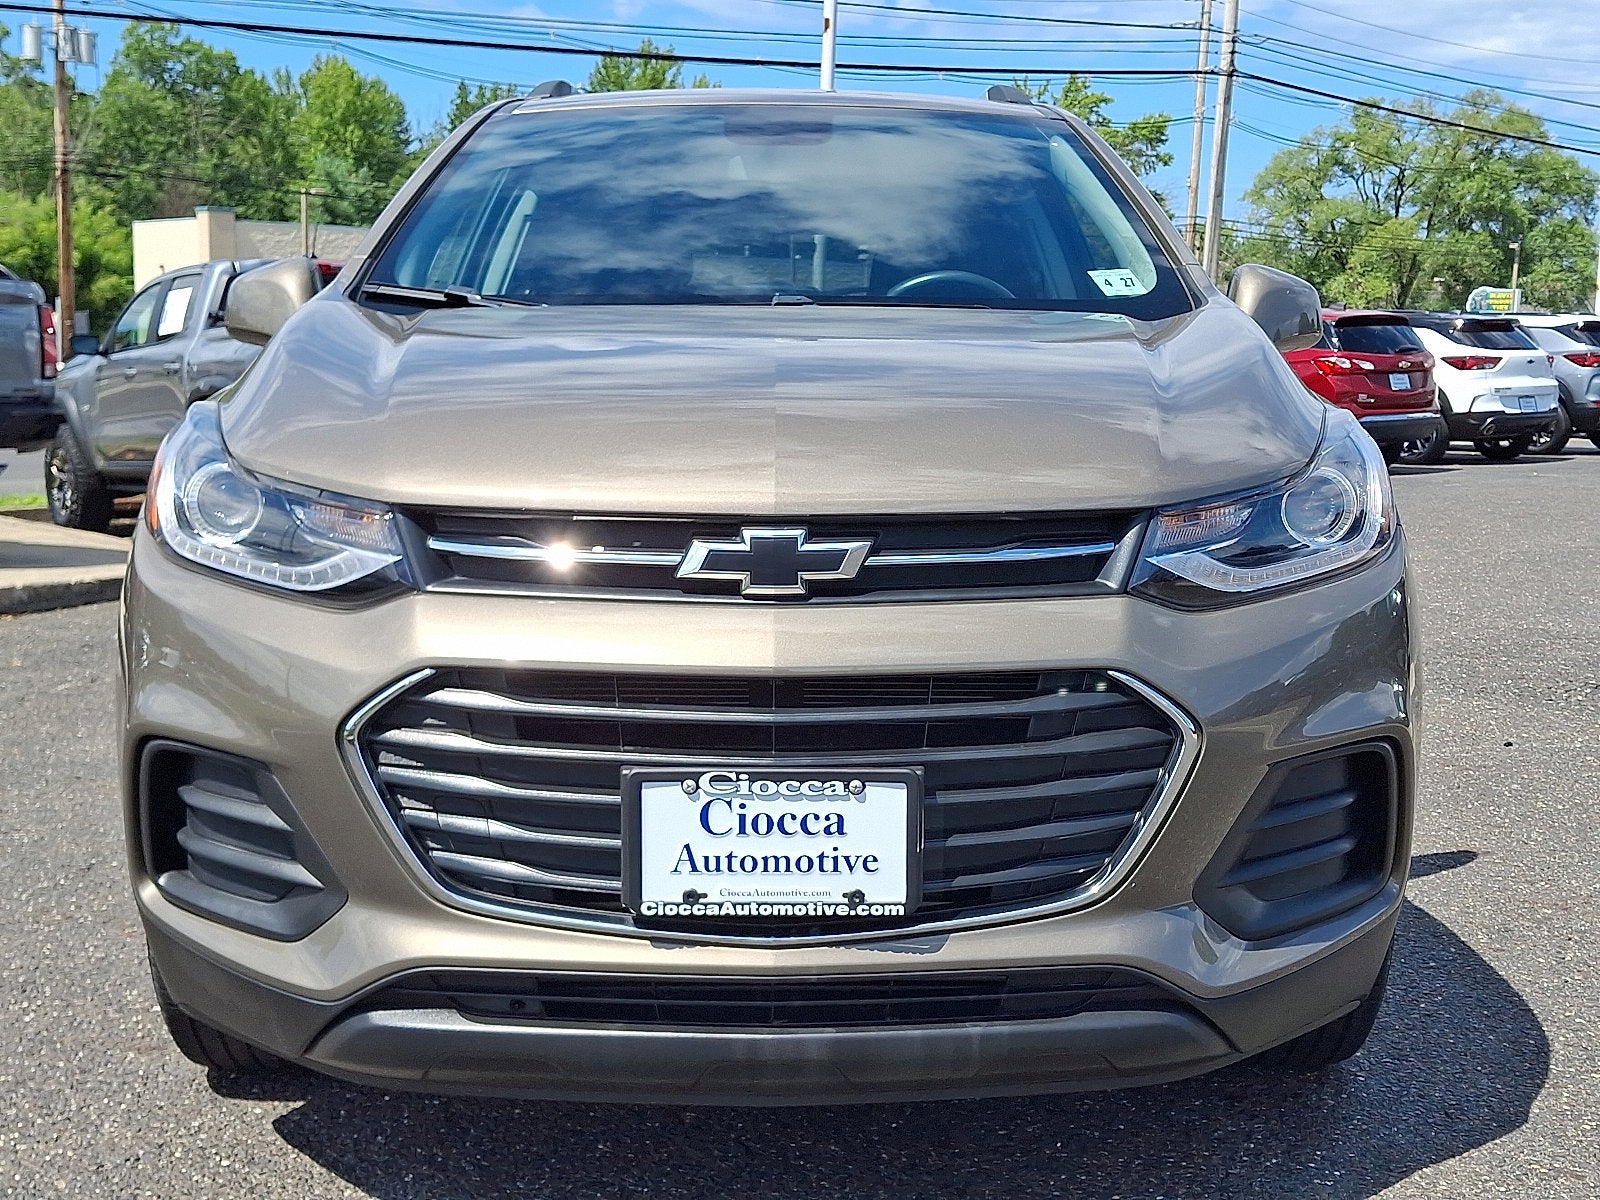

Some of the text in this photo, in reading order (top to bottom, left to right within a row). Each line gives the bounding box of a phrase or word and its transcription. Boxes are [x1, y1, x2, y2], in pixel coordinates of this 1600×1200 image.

[1104, 277, 1135, 287] 4 27
[698, 771, 848, 796] Ciocca
[699, 798, 847, 836] Ciocca
[671, 843, 879, 873] Automotive
[719, 887, 832, 897] CioccaAutomotive.com
[640, 900, 905, 916] CioccaAutomotive.com
